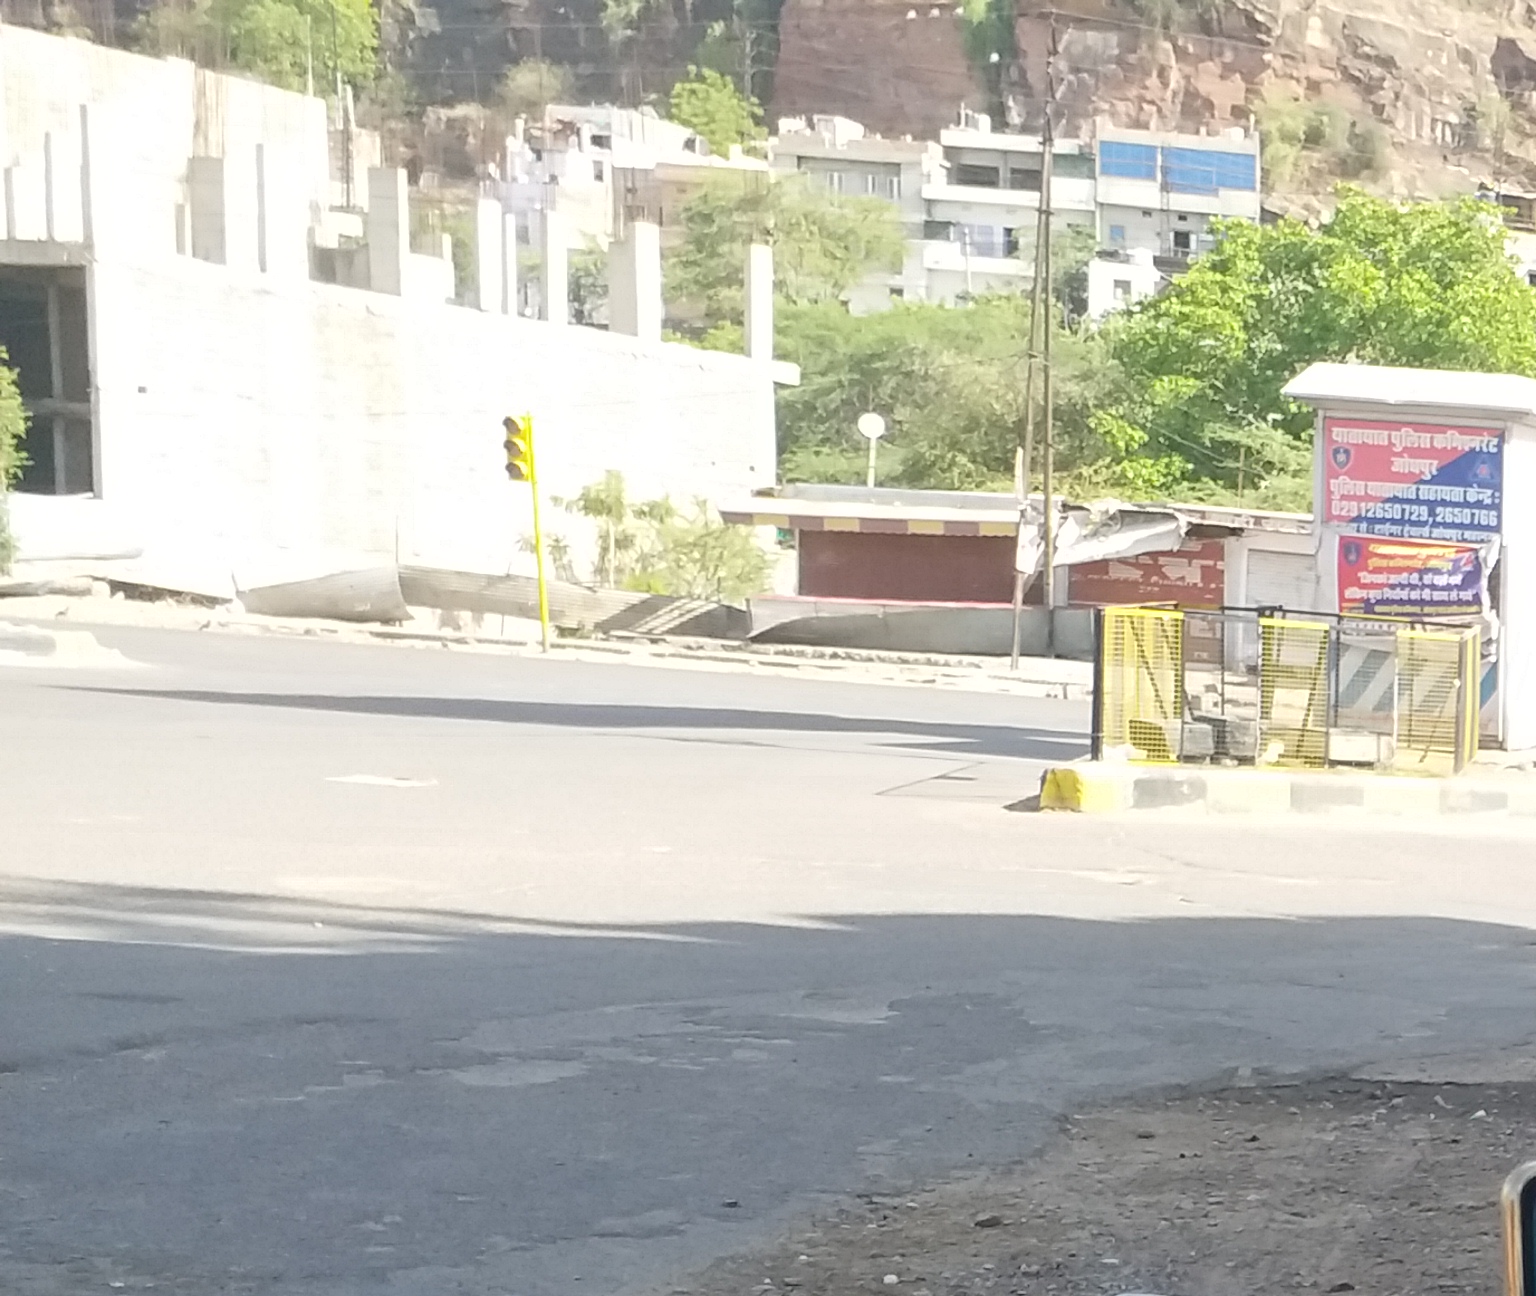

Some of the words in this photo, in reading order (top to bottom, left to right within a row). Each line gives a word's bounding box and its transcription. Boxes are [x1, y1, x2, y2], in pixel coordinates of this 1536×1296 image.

[1331, 426, 1389, 446] यातायात
[1390, 427, 1431, 451] पुलिस
[1433, 430, 1499, 453] कमिश्नरेट
[1391, 453, 1439, 480] जोधपुर
[1330, 475, 1365, 499] पुलिस
[1366, 480, 1416, 499] यातायात
[1418, 484, 1464, 502] सहायता
[1435, 506, 1498, 527] 2650766
